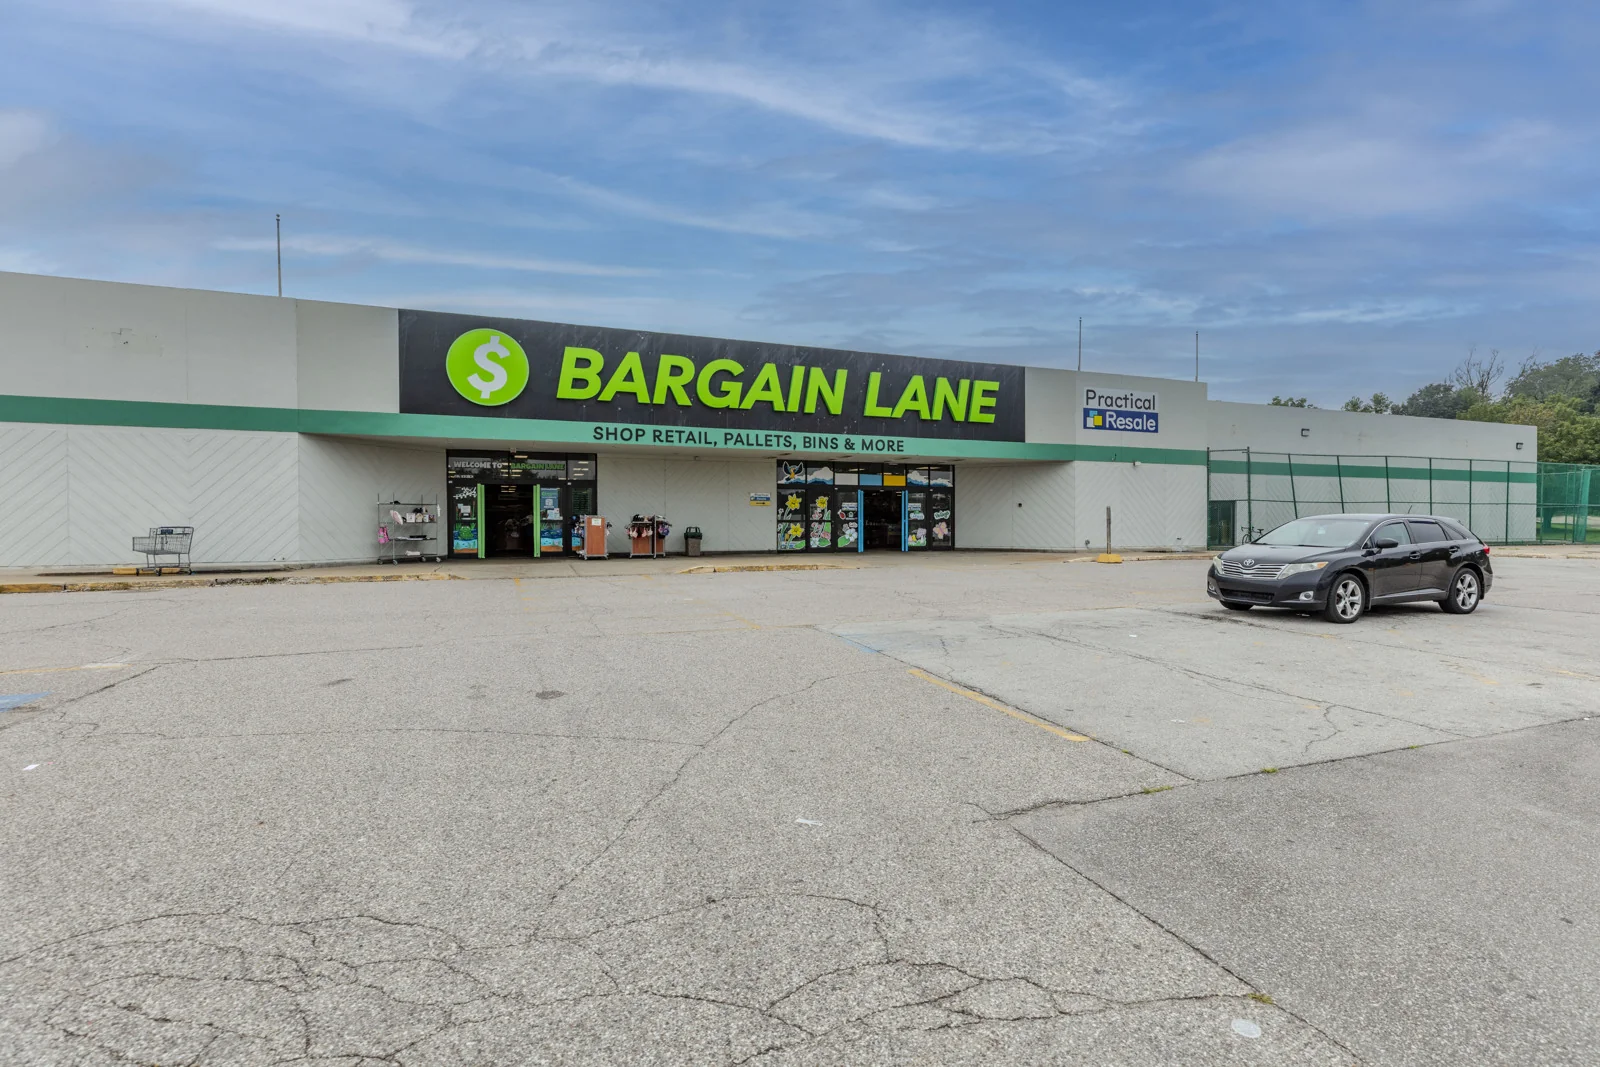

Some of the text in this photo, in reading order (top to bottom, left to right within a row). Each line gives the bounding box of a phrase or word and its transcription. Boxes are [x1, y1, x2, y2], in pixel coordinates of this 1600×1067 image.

[556, 346, 1000, 424] BARGAIN LANE
[1085, 389, 1156, 411] Practical
[1105, 411, 1157, 431] Resale
[592, 426, 905, 452] SHOP RETAIL, PALLETS, BINS & MORE
[453, 461, 491, 469] WELCOME
